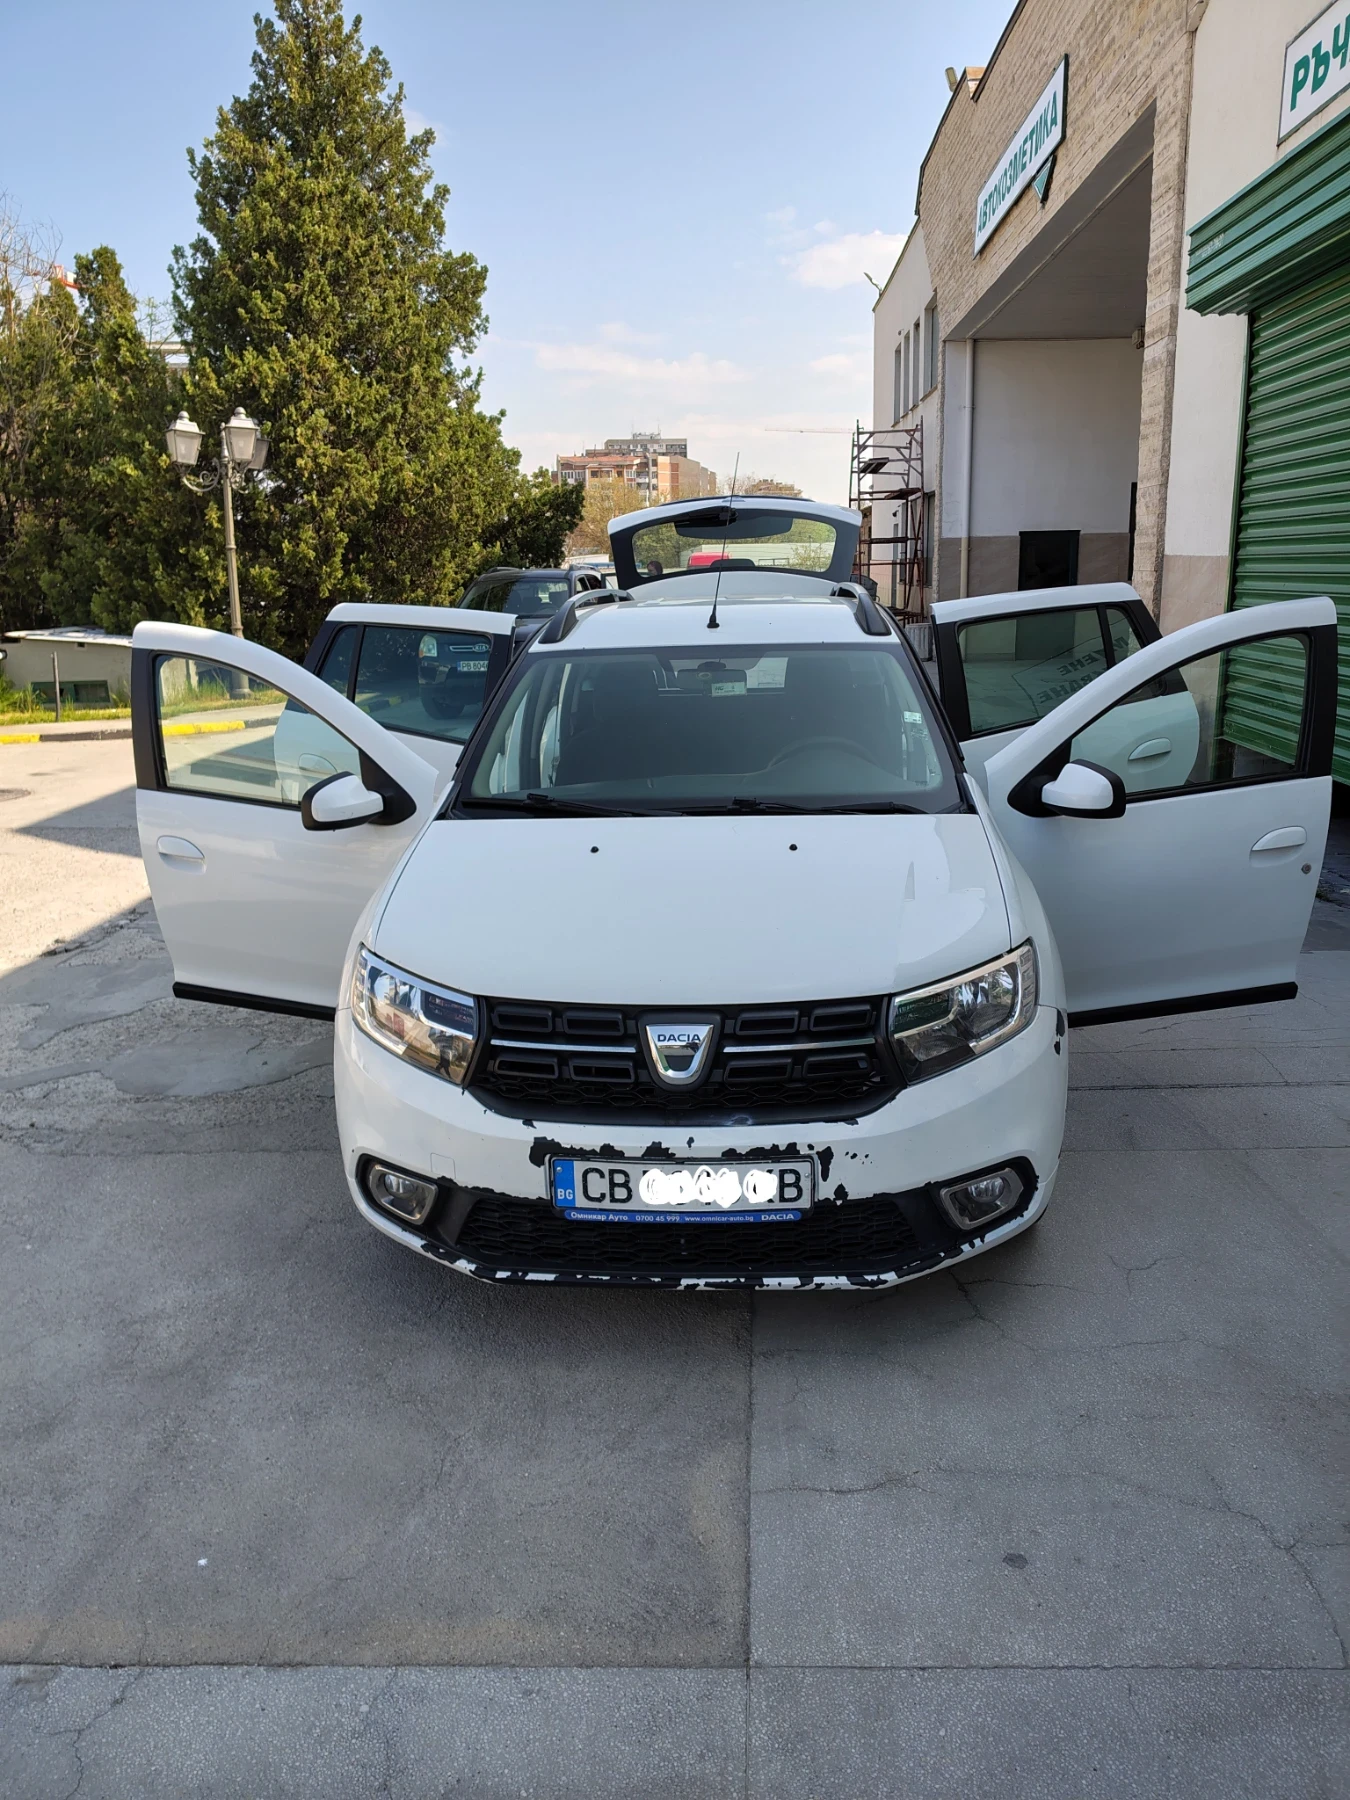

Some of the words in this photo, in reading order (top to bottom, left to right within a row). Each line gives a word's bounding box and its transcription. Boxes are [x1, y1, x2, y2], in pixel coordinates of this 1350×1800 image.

[1290, 13, 1350, 112] РЪЧ
[976, 90, 1058, 238] АВТОКОЗМЕТИКА
[657, 1033, 701, 1043] DACIA
[582, 1167, 633, 1203] CB
[557, 1189, 573, 1200] BG
[571, 1211, 606, 1222] Омникар
[608, 1213, 628, 1222] Ауто
[684, 1214, 754, 1222] www.omnicar-auto.bg
[761, 1213, 795, 1221] DACIA
